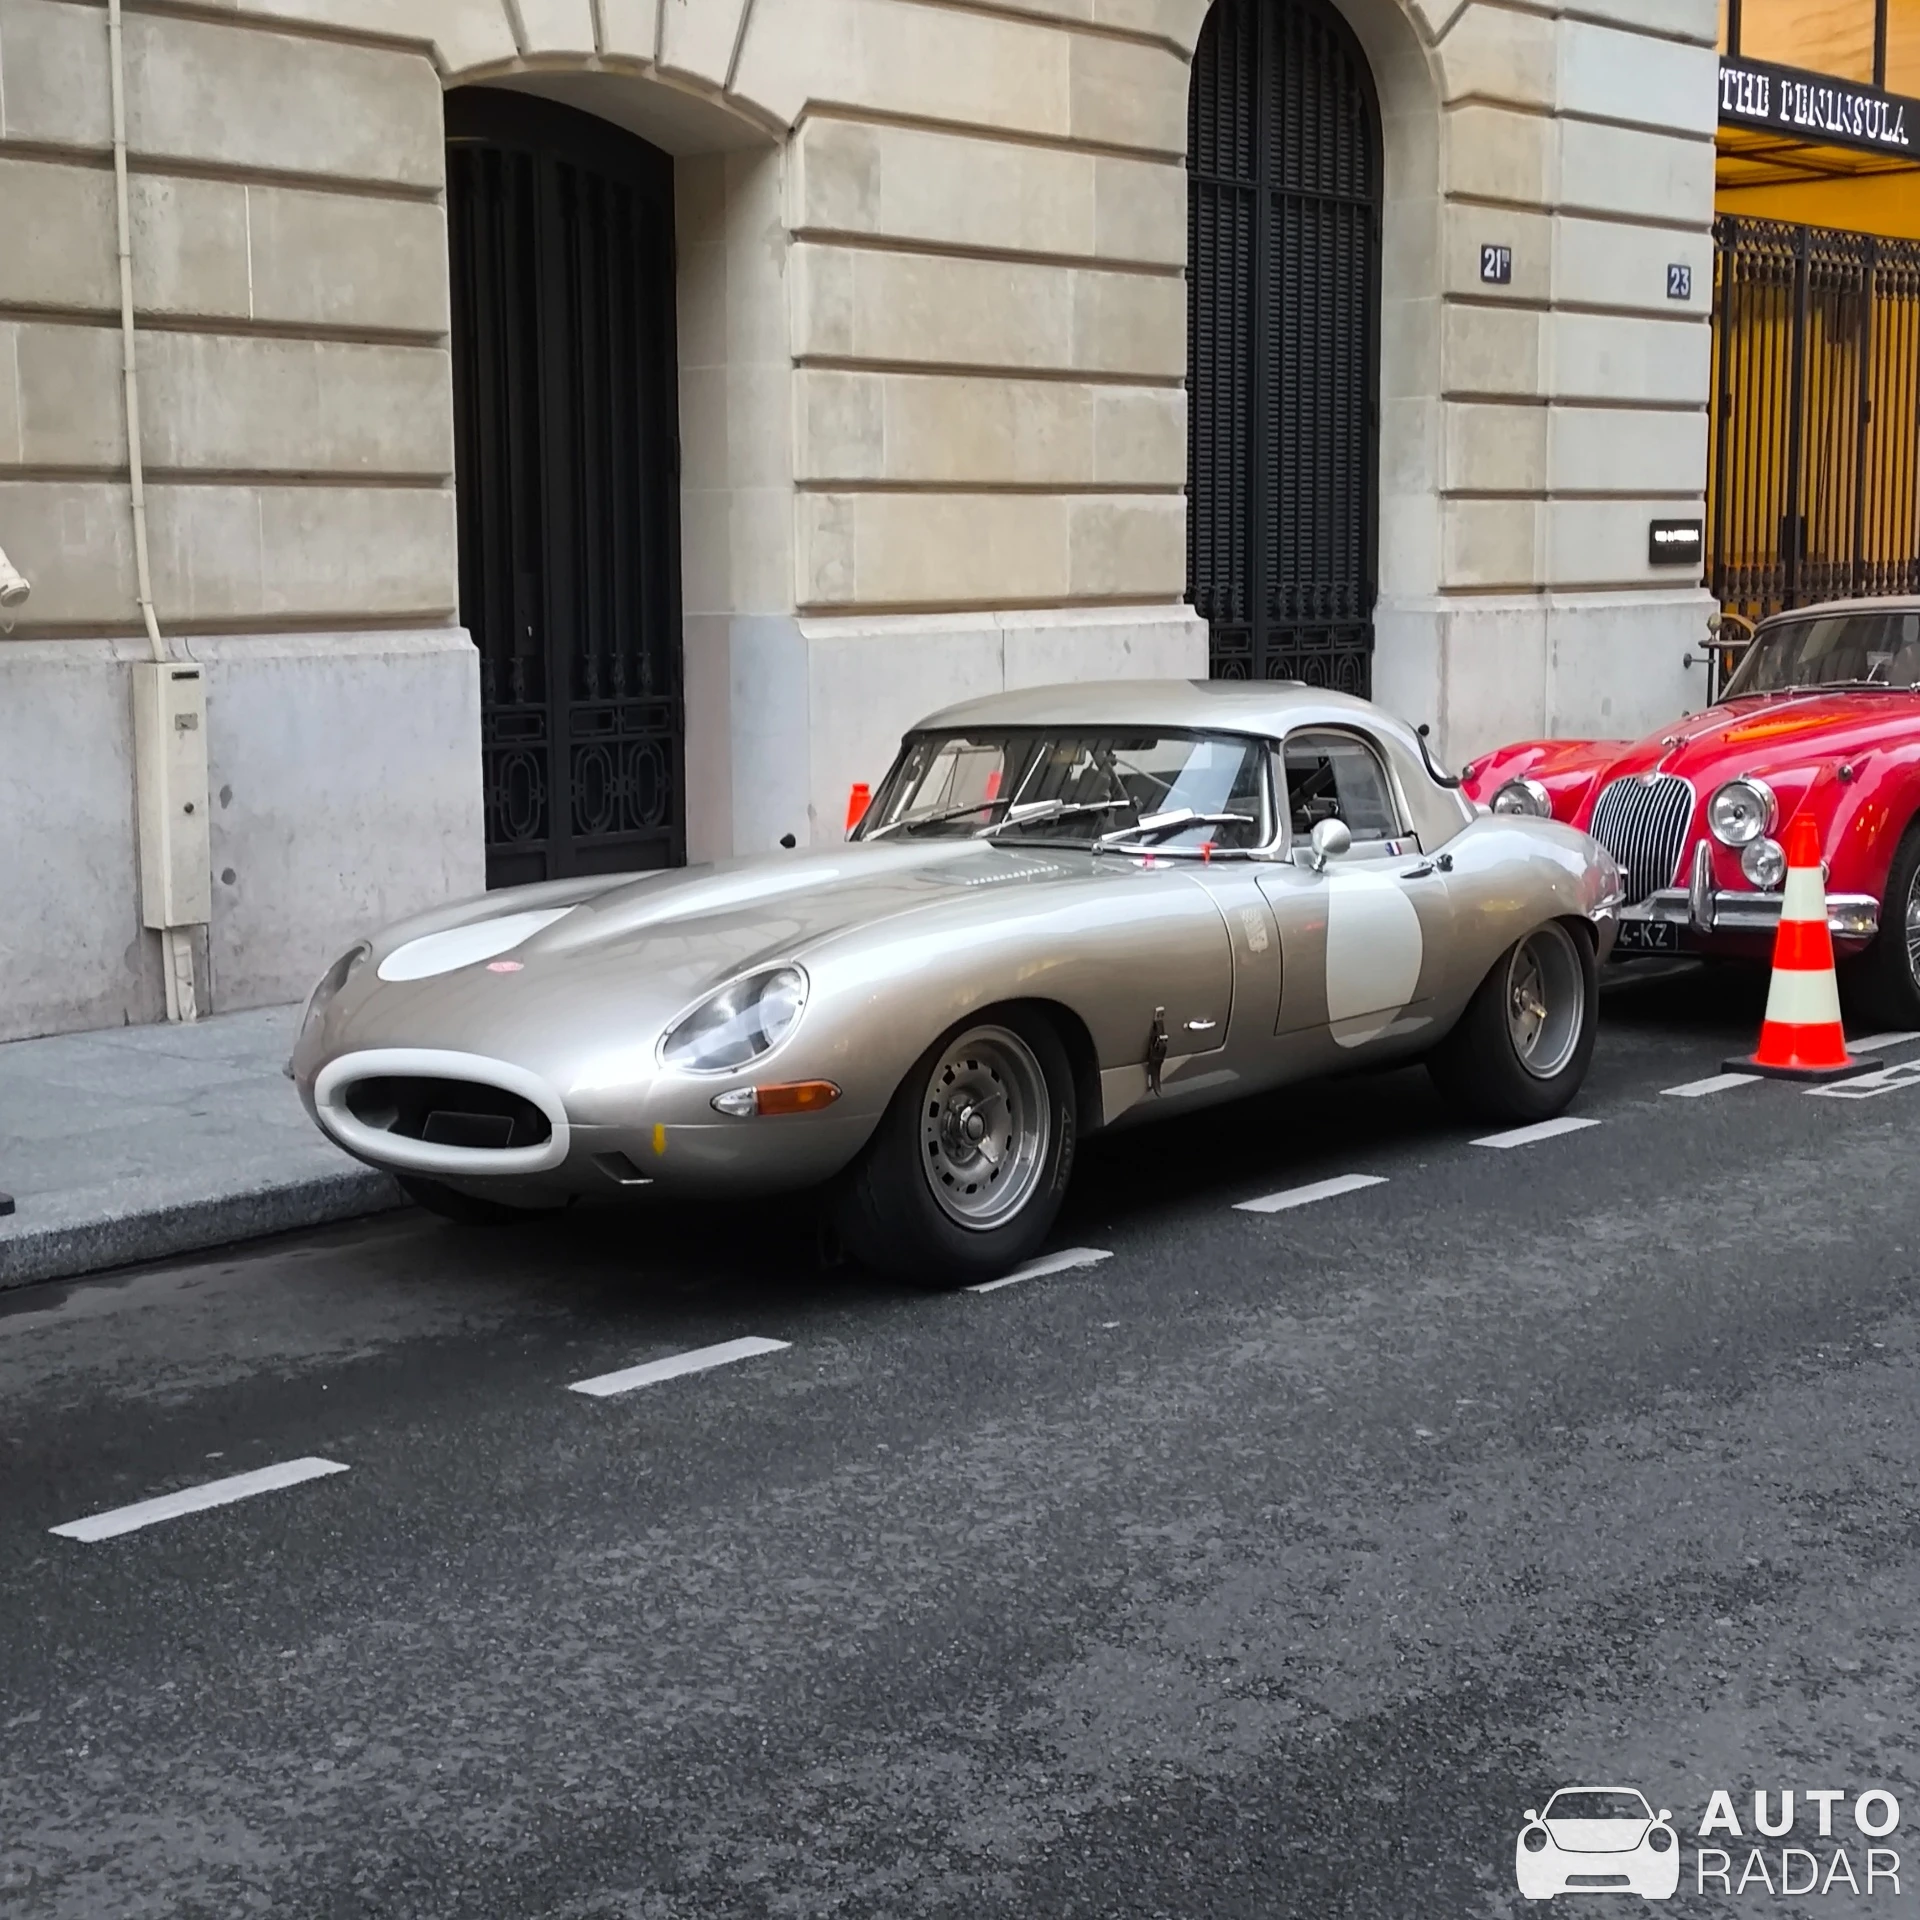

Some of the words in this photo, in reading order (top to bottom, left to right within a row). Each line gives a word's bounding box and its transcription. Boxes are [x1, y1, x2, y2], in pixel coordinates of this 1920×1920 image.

[1719, 67, 1770, 118] THE
[1780, 80, 1910, 146] PENINSULA
[1670, 267, 1689, 296] 23
